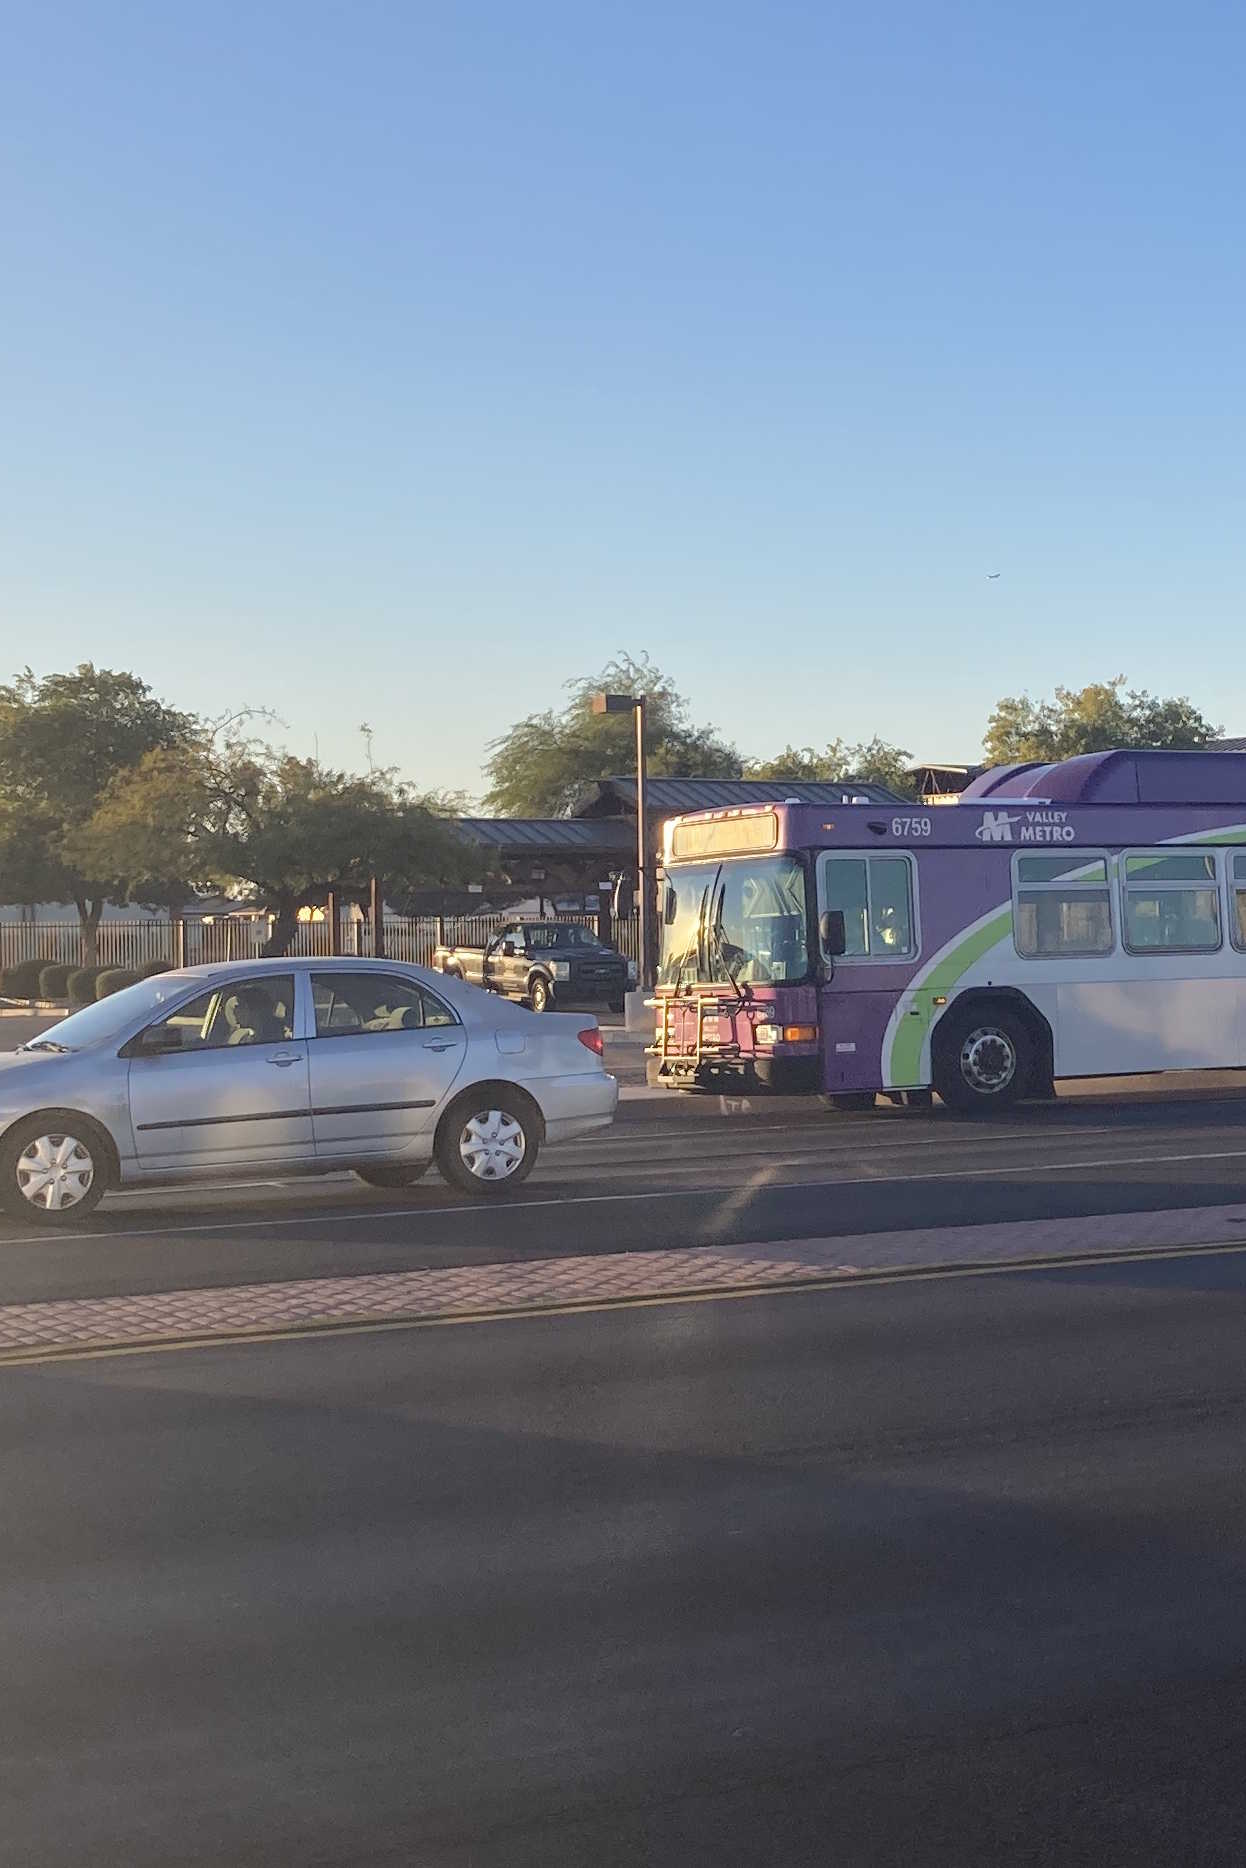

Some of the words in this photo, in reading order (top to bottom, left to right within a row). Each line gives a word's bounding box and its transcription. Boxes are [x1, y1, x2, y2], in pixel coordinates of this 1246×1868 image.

[1025, 811, 1068, 823] VALLEY
[891, 817, 932, 837] 6759
[1020, 826, 1076, 842] METRO
